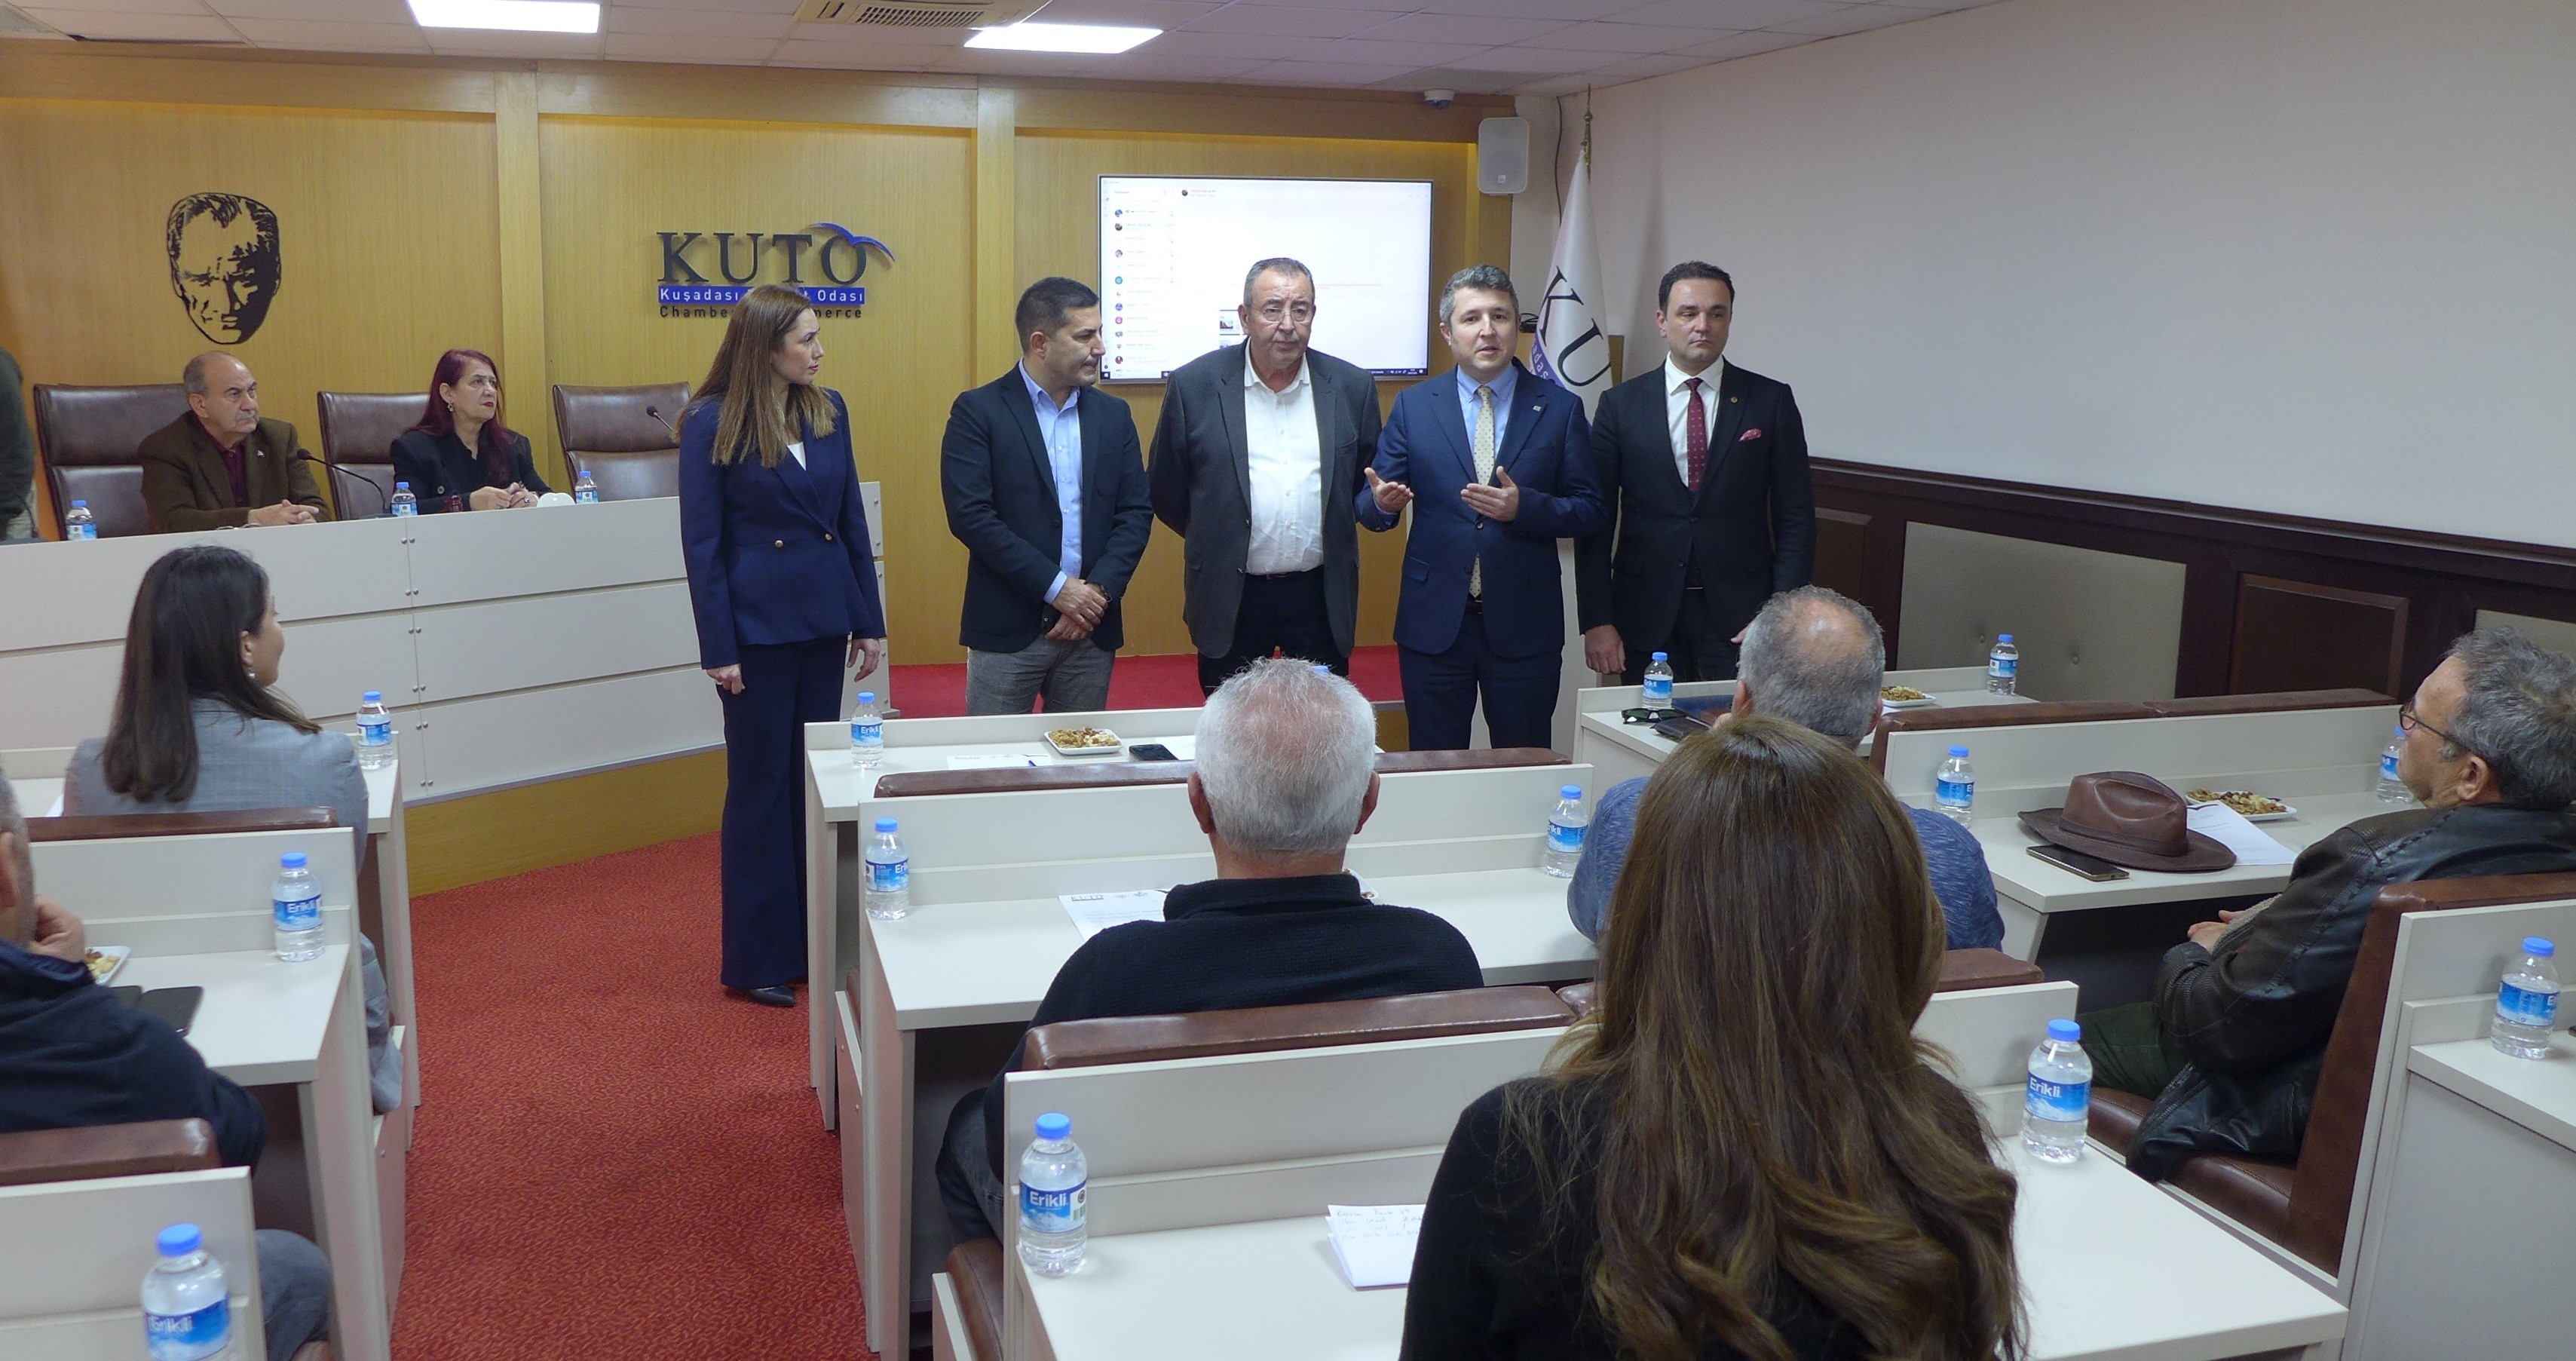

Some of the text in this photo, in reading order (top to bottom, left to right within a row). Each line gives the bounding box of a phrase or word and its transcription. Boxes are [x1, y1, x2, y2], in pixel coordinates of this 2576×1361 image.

[657, 232, 867, 285] KUTO
[660, 288, 739, 302] Kuşadası
[817, 290, 862, 302] Odası
[660, 305, 862, 318] Chambe merce
[2029, 1077, 2061, 1098] Erikli
[1030, 1191, 1067, 1207] Erikli
